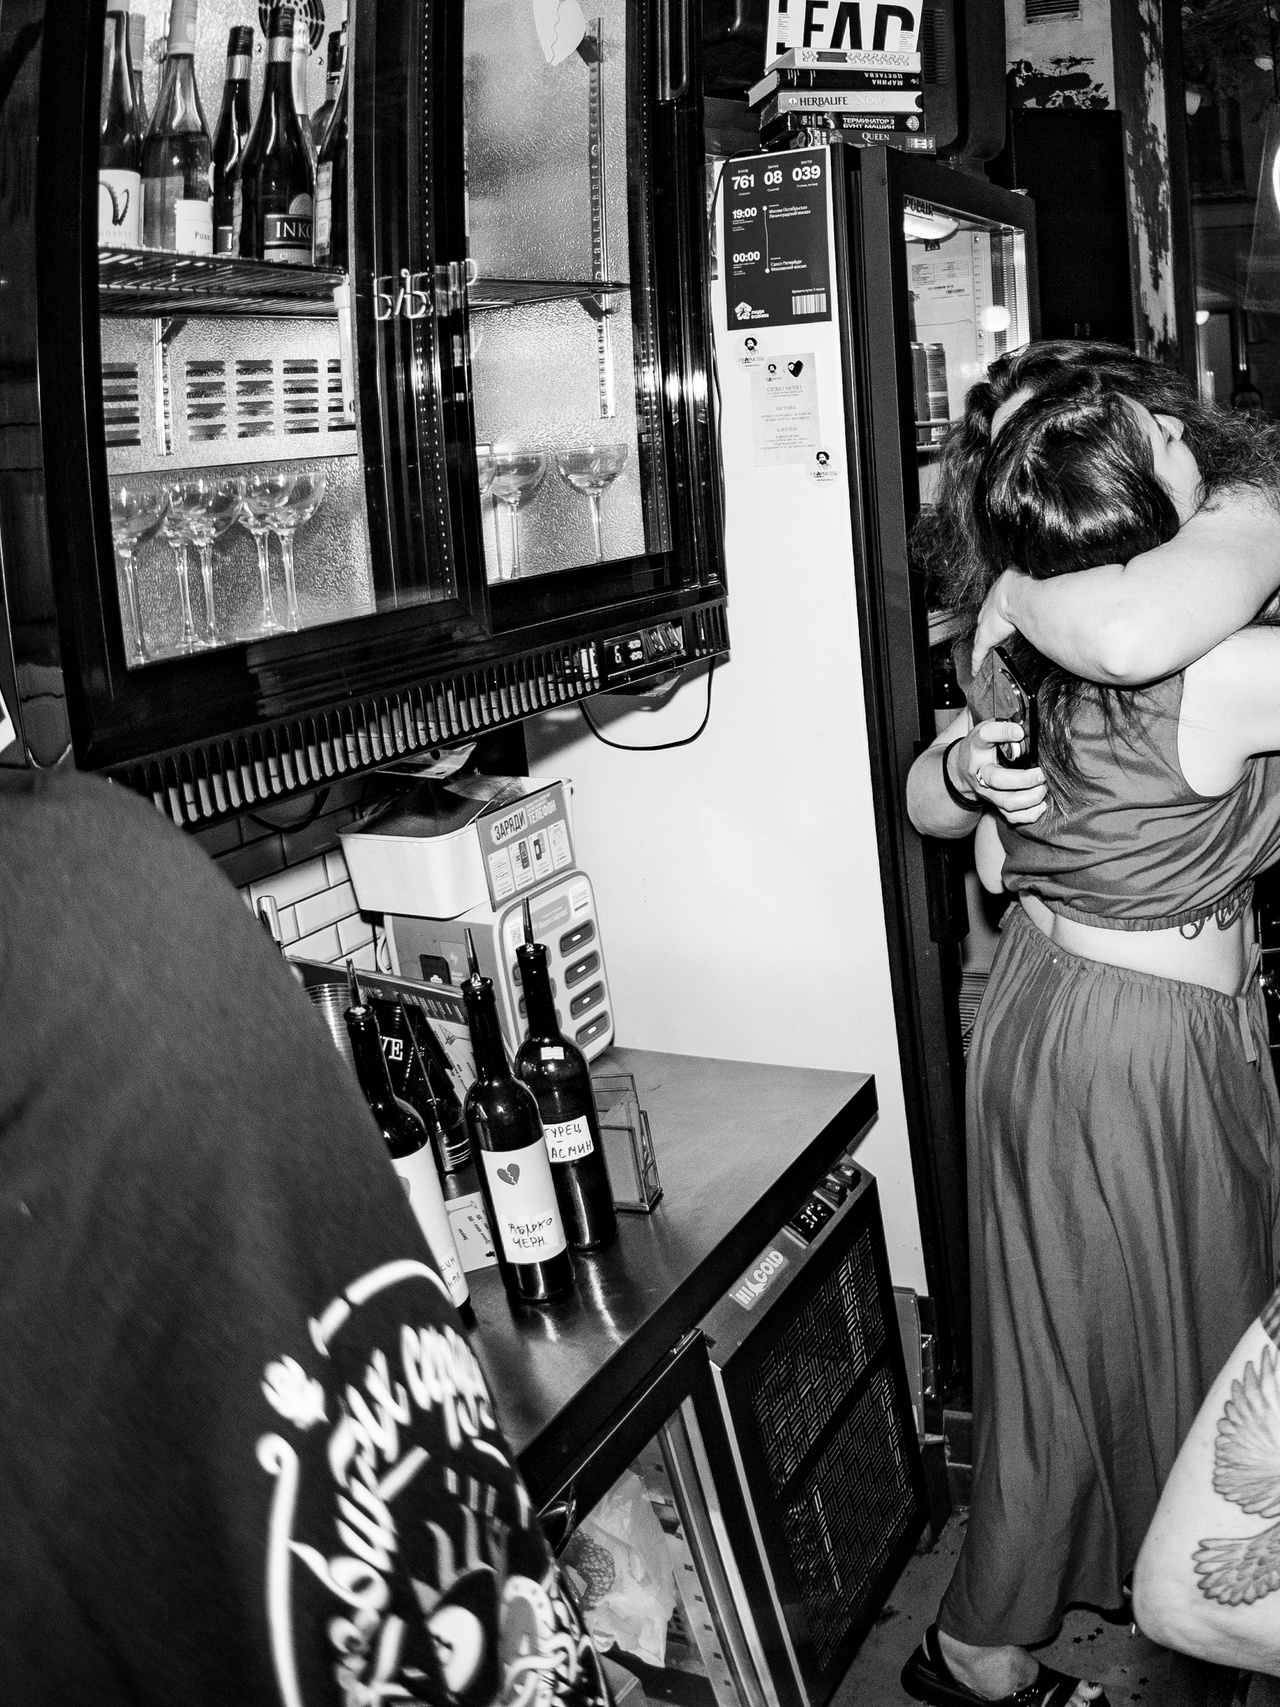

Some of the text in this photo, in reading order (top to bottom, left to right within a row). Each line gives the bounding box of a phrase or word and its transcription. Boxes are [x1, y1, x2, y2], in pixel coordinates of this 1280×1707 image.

[871, 78, 904, 86] МАРИНА
[799, 96, 849, 106] HERBALIFE
[842, 117, 888, 125] ТЕРМИНАТОР
[862, 131, 890, 143] QUEEN
[731, 165, 821, 190] 761 08 039
[732, 207, 757, 219] 19:00
[733, 251, 760, 263] 00:00
[527, 799, 557, 825] ТЕЛЕФОН
[494, 811, 526, 841] ЗАРЯДИ
[544, 1124, 582, 1139] ГУРЕЦ
[552, 1140, 592, 1159] АСМИН
